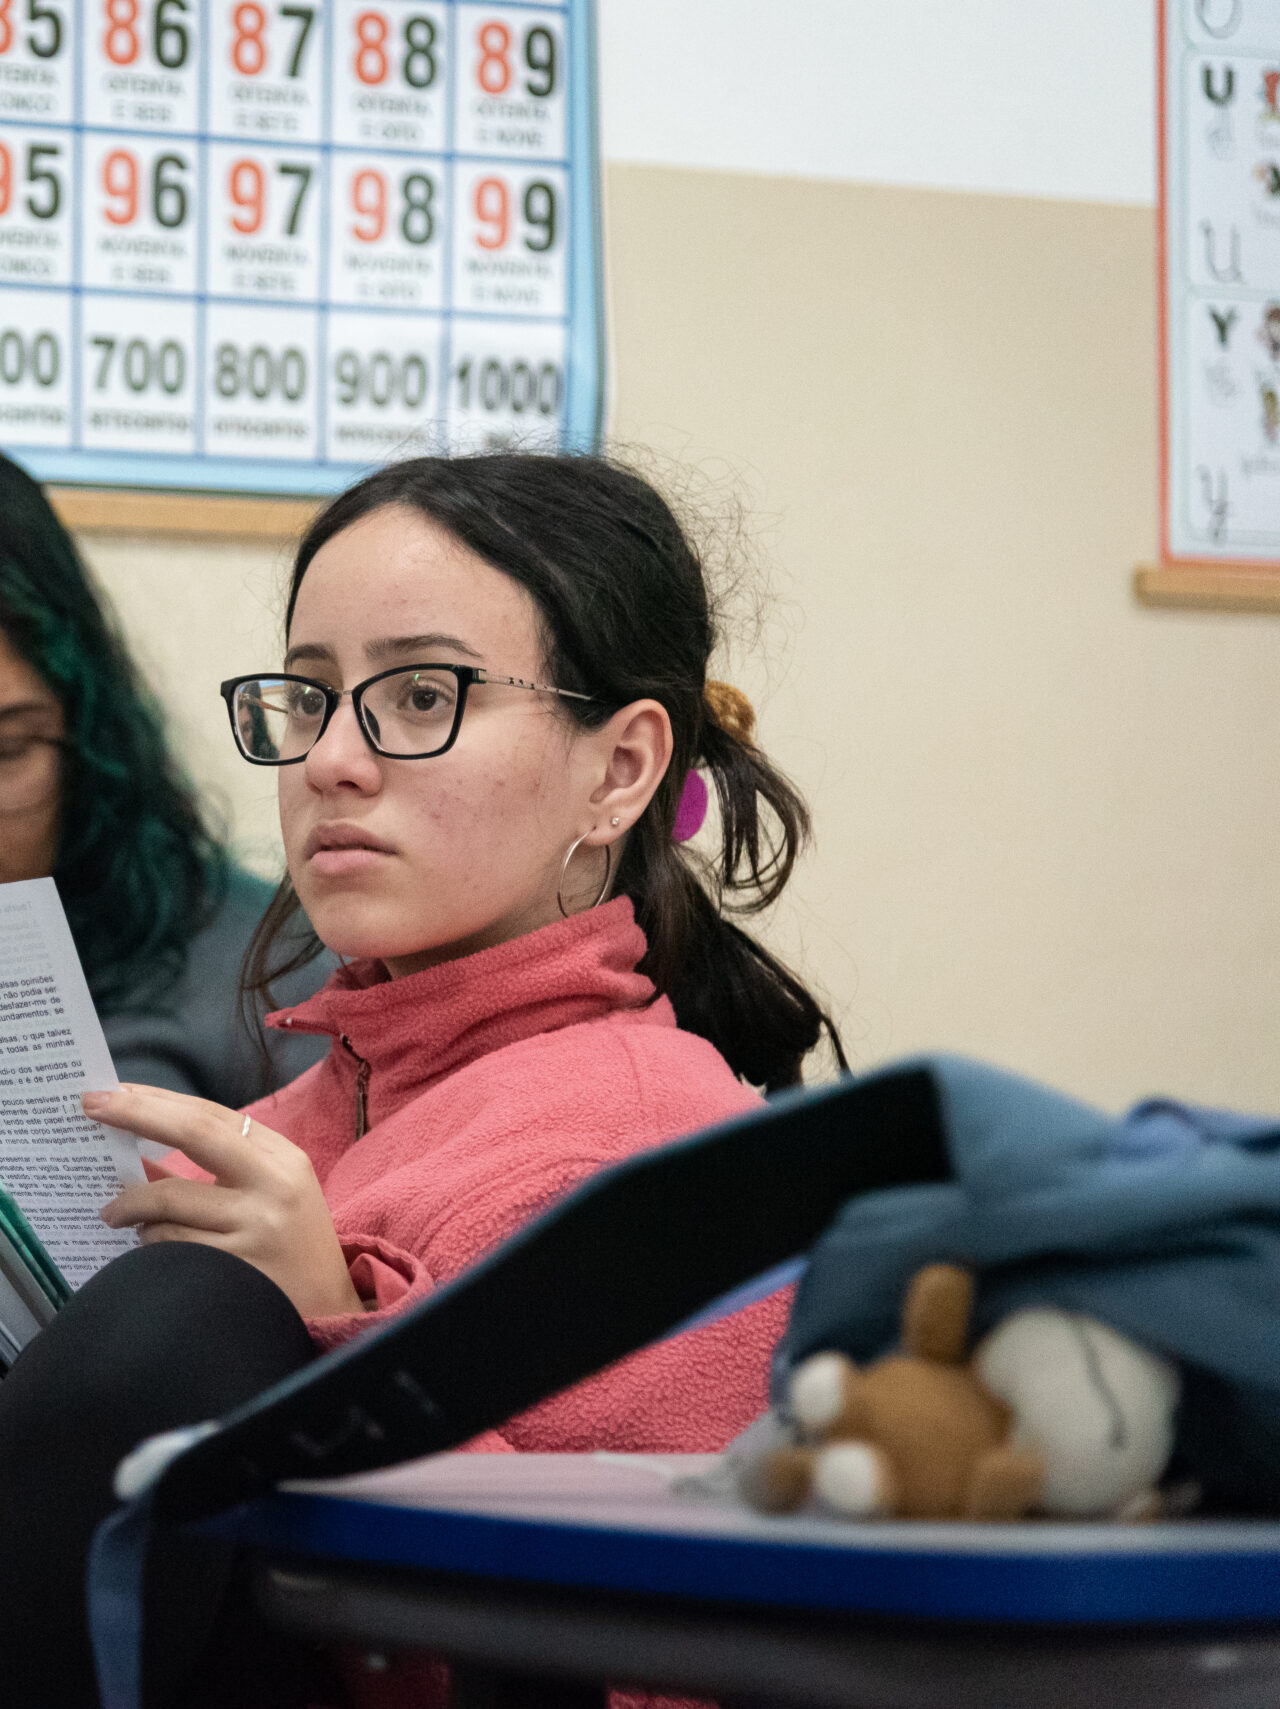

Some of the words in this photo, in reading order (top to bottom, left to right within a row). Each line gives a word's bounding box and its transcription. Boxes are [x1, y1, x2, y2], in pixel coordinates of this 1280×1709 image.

[104, 0, 188, 68] 86
[232, 2, 314, 77] 87
[355, 12, 436, 88] 88
[478, 22, 555, 97] 89
[1202, 62, 1235, 107] U
[103, 150, 187, 228] 96
[230, 160, 312, 235] 97
[353, 168, 435, 244] 98
[475, 177, 555, 252] 99
[1209, 304, 1236, 347] Y
[90, 337, 186, 395] 700
[216, 341, 308, 400] 800
[336, 351, 428, 409] 900
[457, 354, 560, 416] 1000
[3, 991, 18, 999] não
[20, 988, 42, 998] podia
[20, 975, 54, 987] opiniões
[6, 1044, 28, 1053] todas
[45, 1039, 74, 1048] minhas
[30, 1032, 44, 1042] que
[46, 1029, 72, 1038] talvez
[34, 1062, 68, 1072] sentidos
[45, 1070, 85, 1083] prudência
